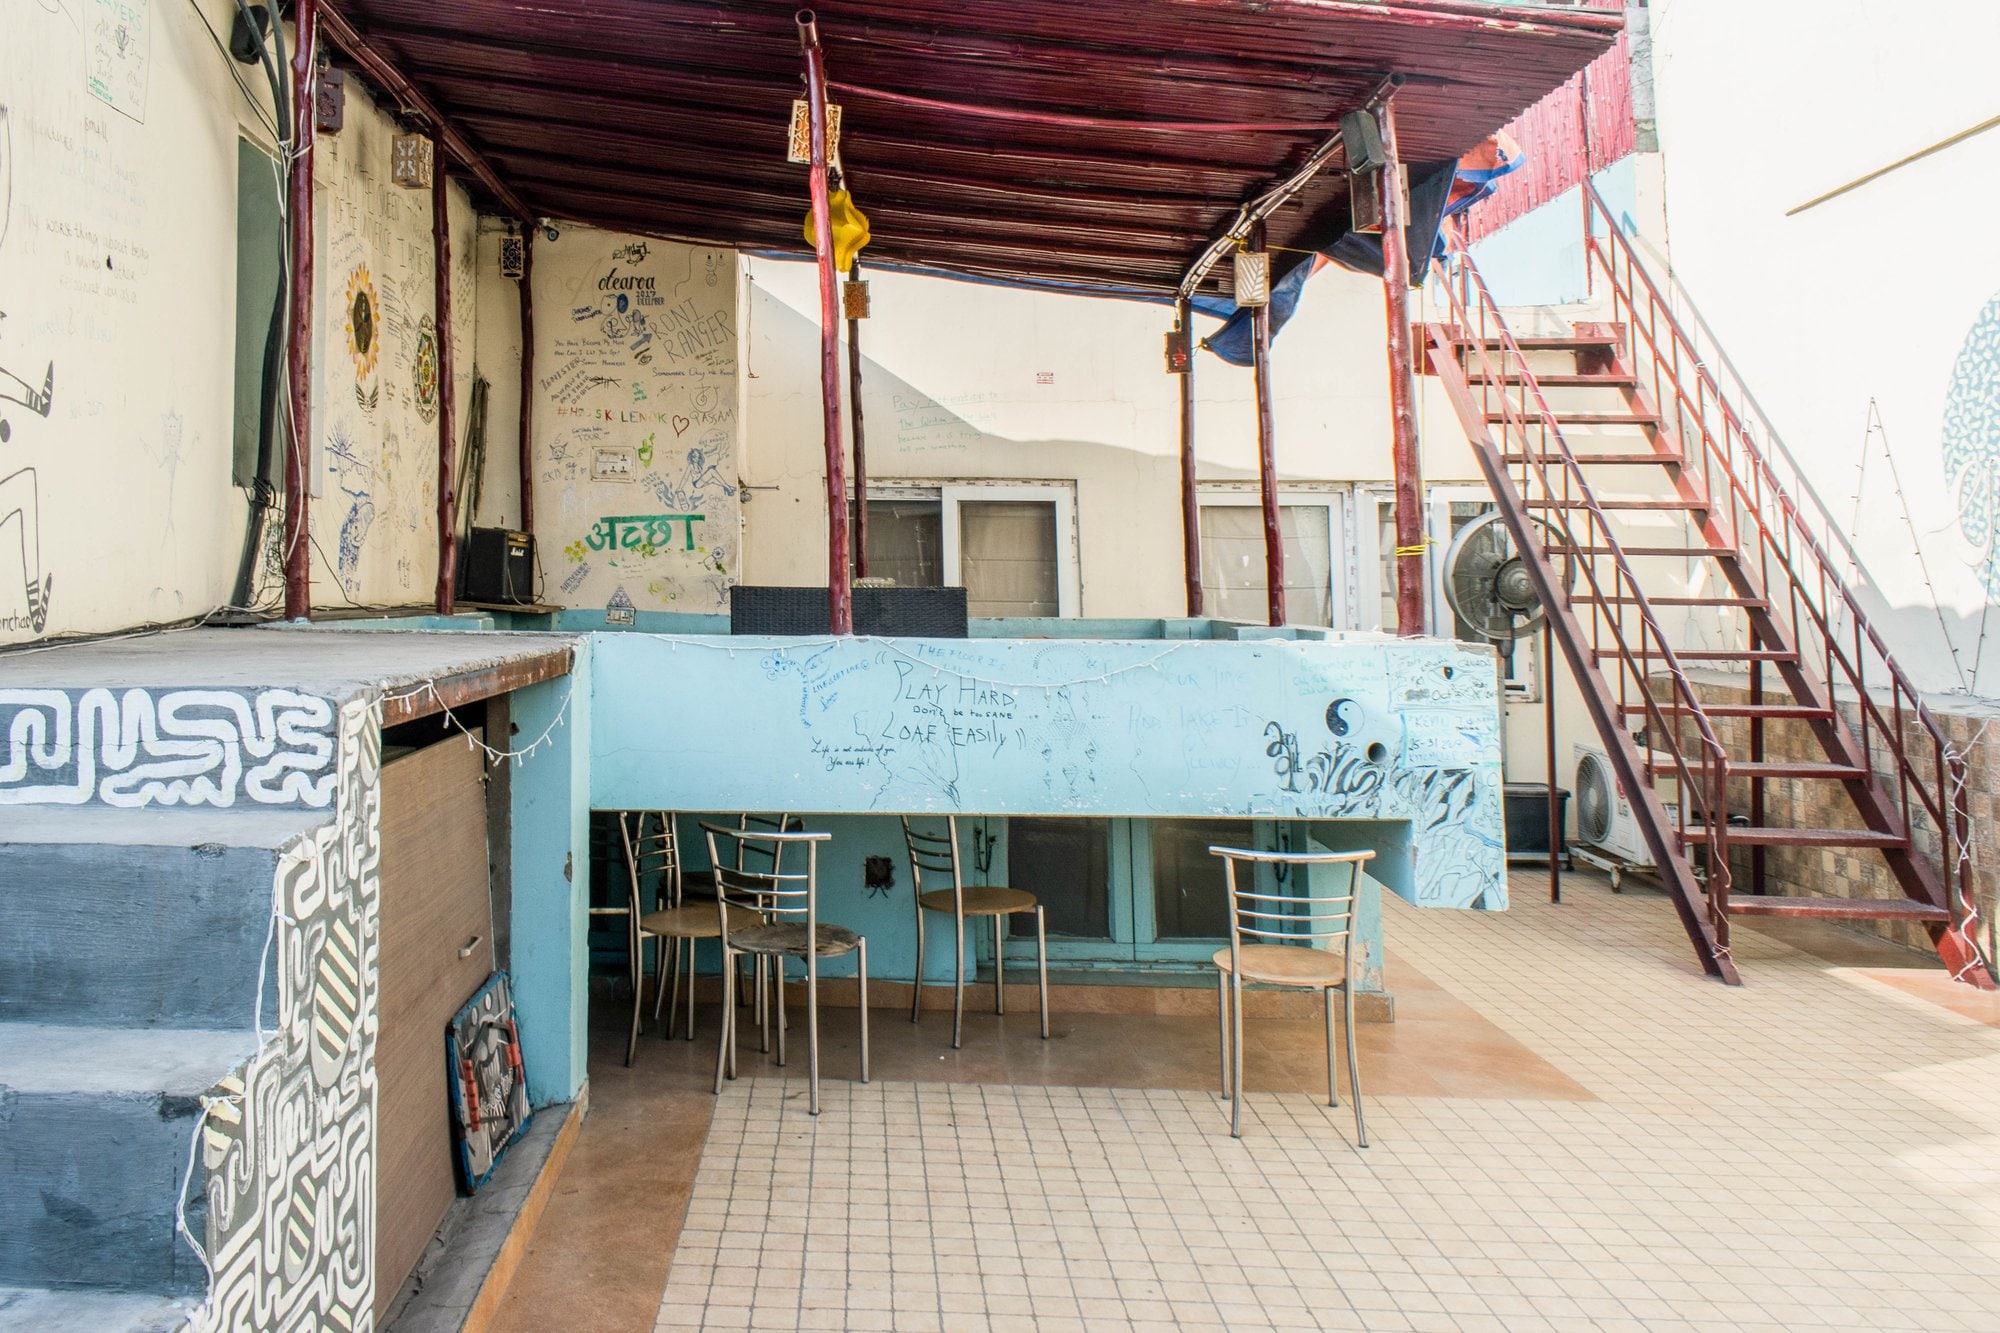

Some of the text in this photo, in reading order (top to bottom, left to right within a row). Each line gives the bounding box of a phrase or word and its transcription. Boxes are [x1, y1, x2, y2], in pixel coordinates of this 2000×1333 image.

[635, 290, 657, 298] 2017
[649, 297, 704, 340] RONI
[663, 310, 736, 364] RANGER
[893, 395, 920, 415] Pay
[585, 514, 705, 551] अच्छा
[916, 643, 945, 657] THE
[953, 708, 964, 717] be
[986, 711, 1014, 720] SANE
[1617, 802, 1629, 817] LG
